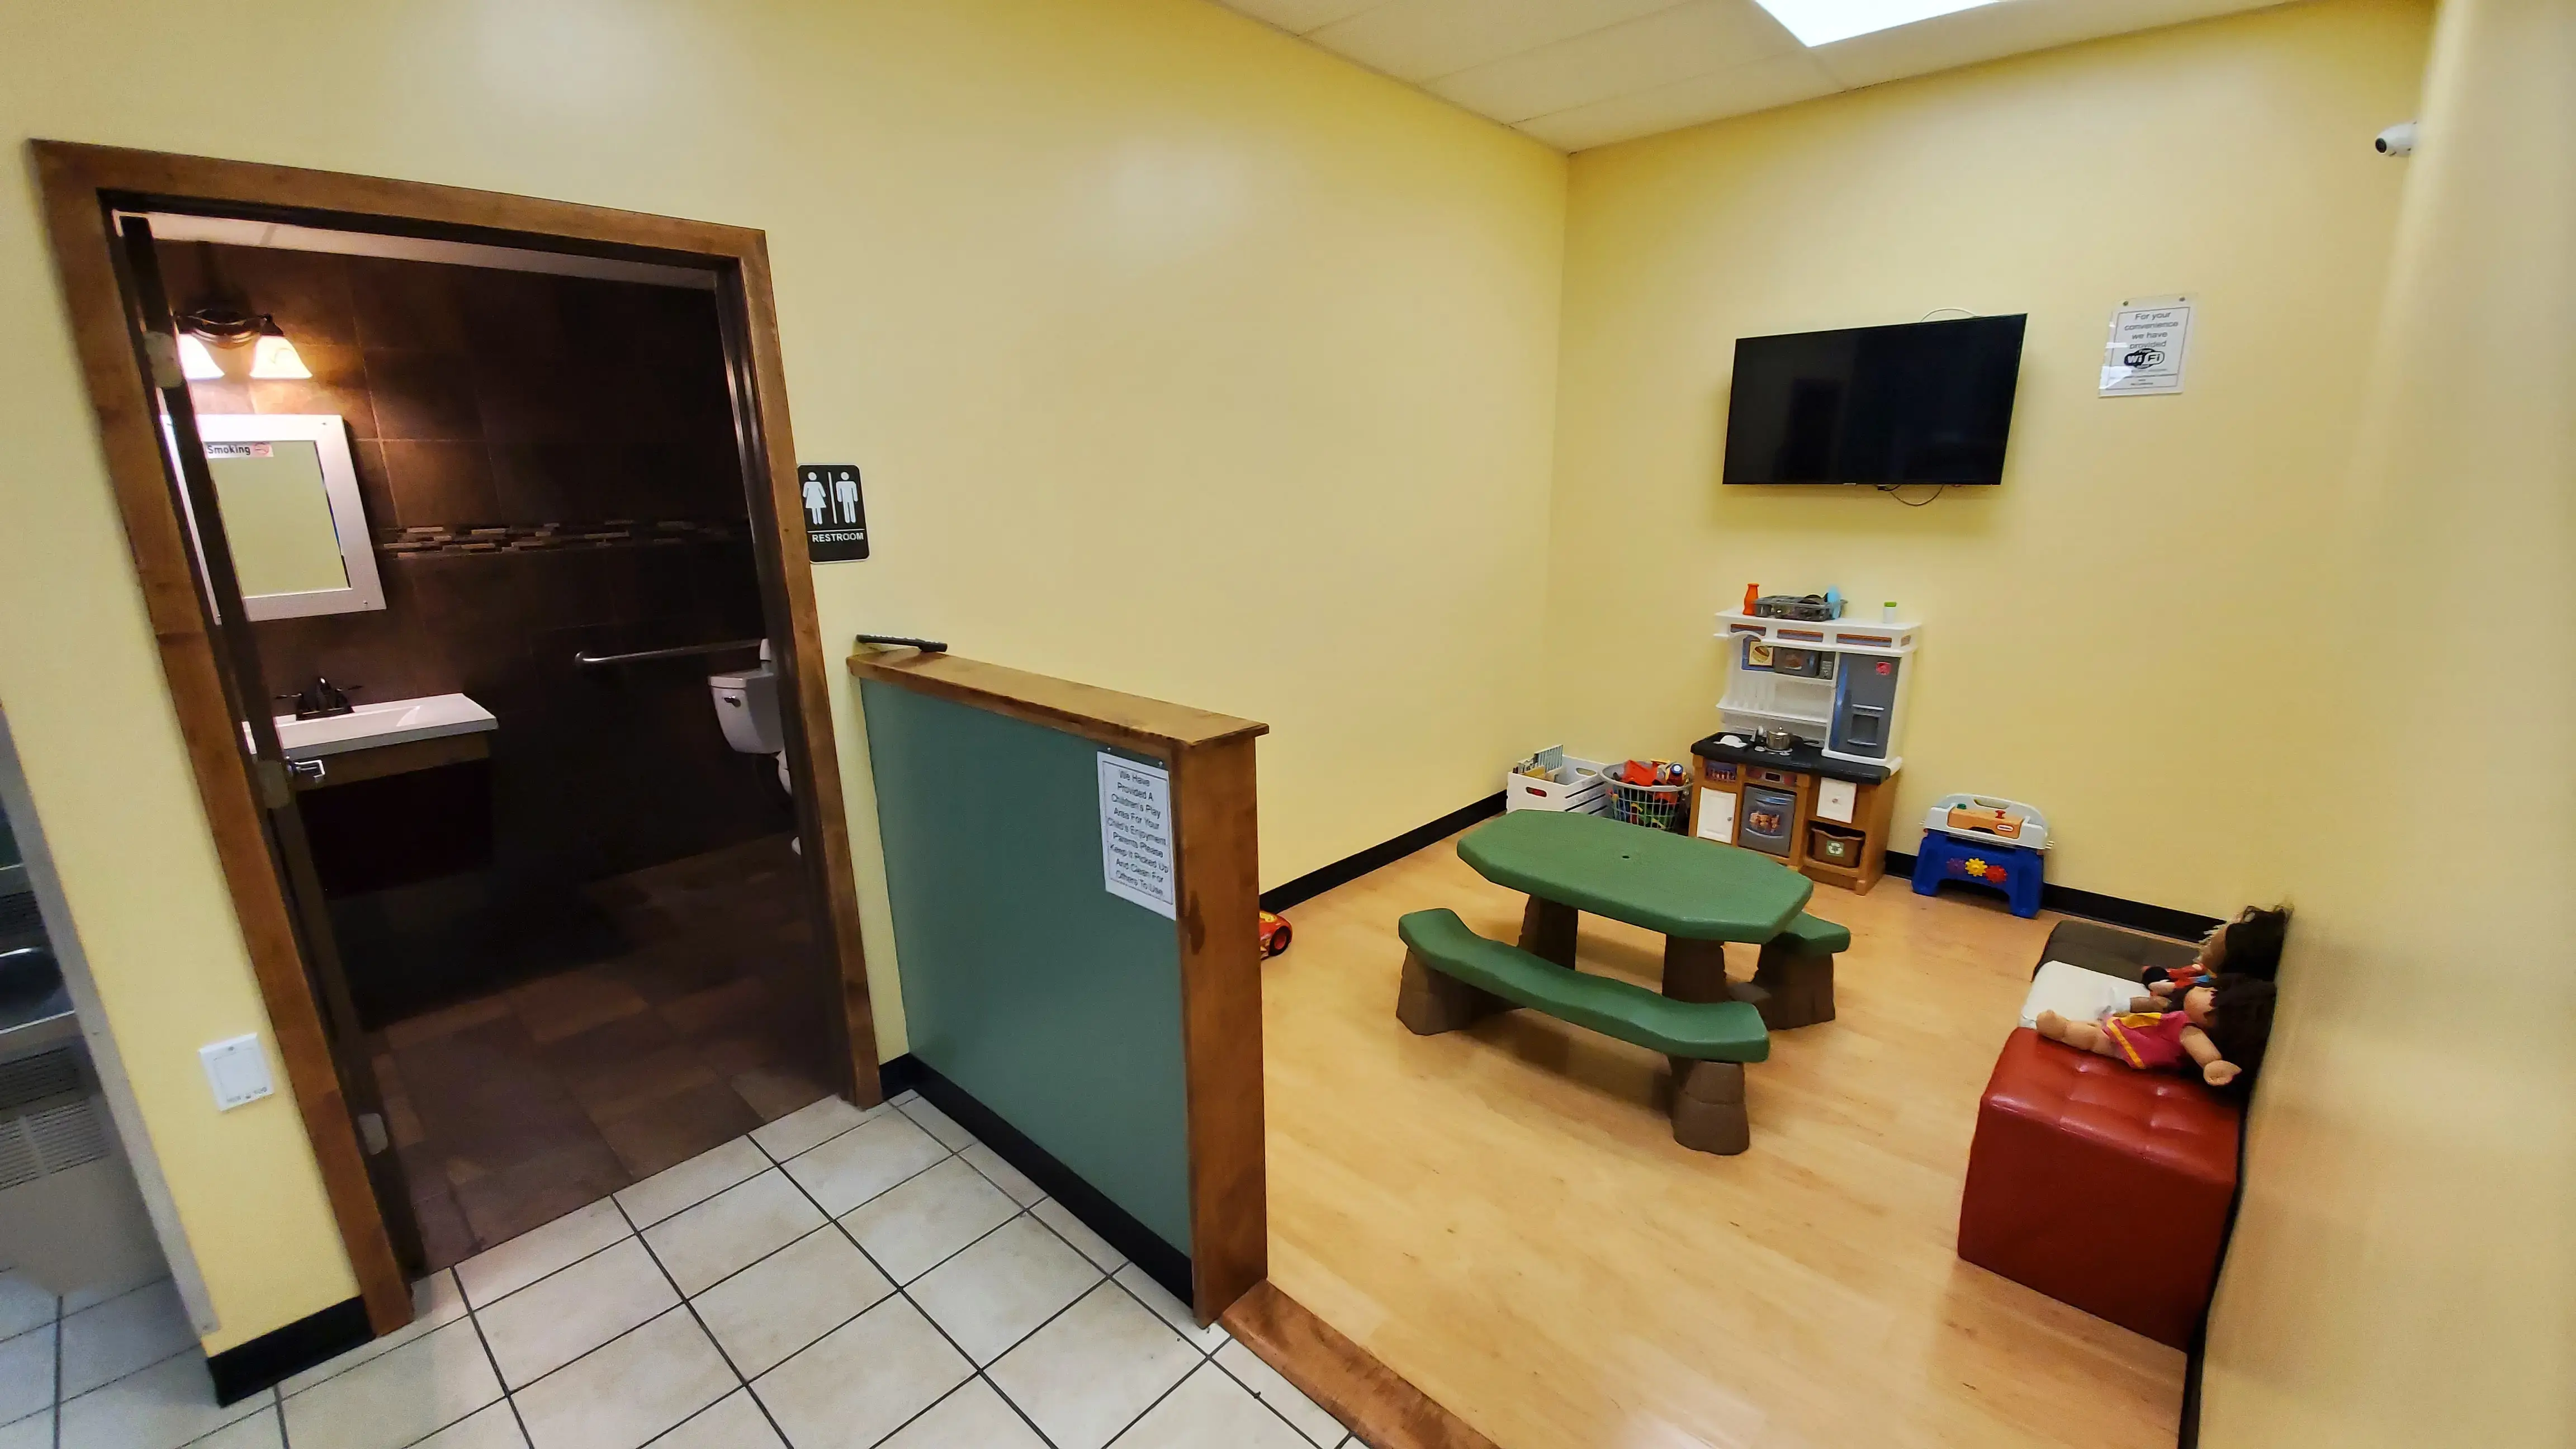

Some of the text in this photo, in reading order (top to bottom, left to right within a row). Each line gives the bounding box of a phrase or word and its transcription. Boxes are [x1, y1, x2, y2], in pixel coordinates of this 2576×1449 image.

[2152, 312, 2171, 320] your
[2124, 321, 2179, 330] convenience
[2129, 340, 2167, 349] provided
[207, 445, 251, 456] Smoking
[812, 532, 864, 543] RESTROOM
[1119, 770, 1150, 787] We Have
[1117, 782, 1154, 801] Provided A
[1114, 807, 1159, 829] Area For Your
[1146, 804, 1161, 820] Play
[1113, 831, 1163, 858] Parents Please
[1116, 858, 1129, 870] And
[1152, 871, 1163, 883] For
[1134, 852, 1157, 868] Picked
[1158, 863, 1168, 873] Up
[1139, 879, 1148, 889] To
